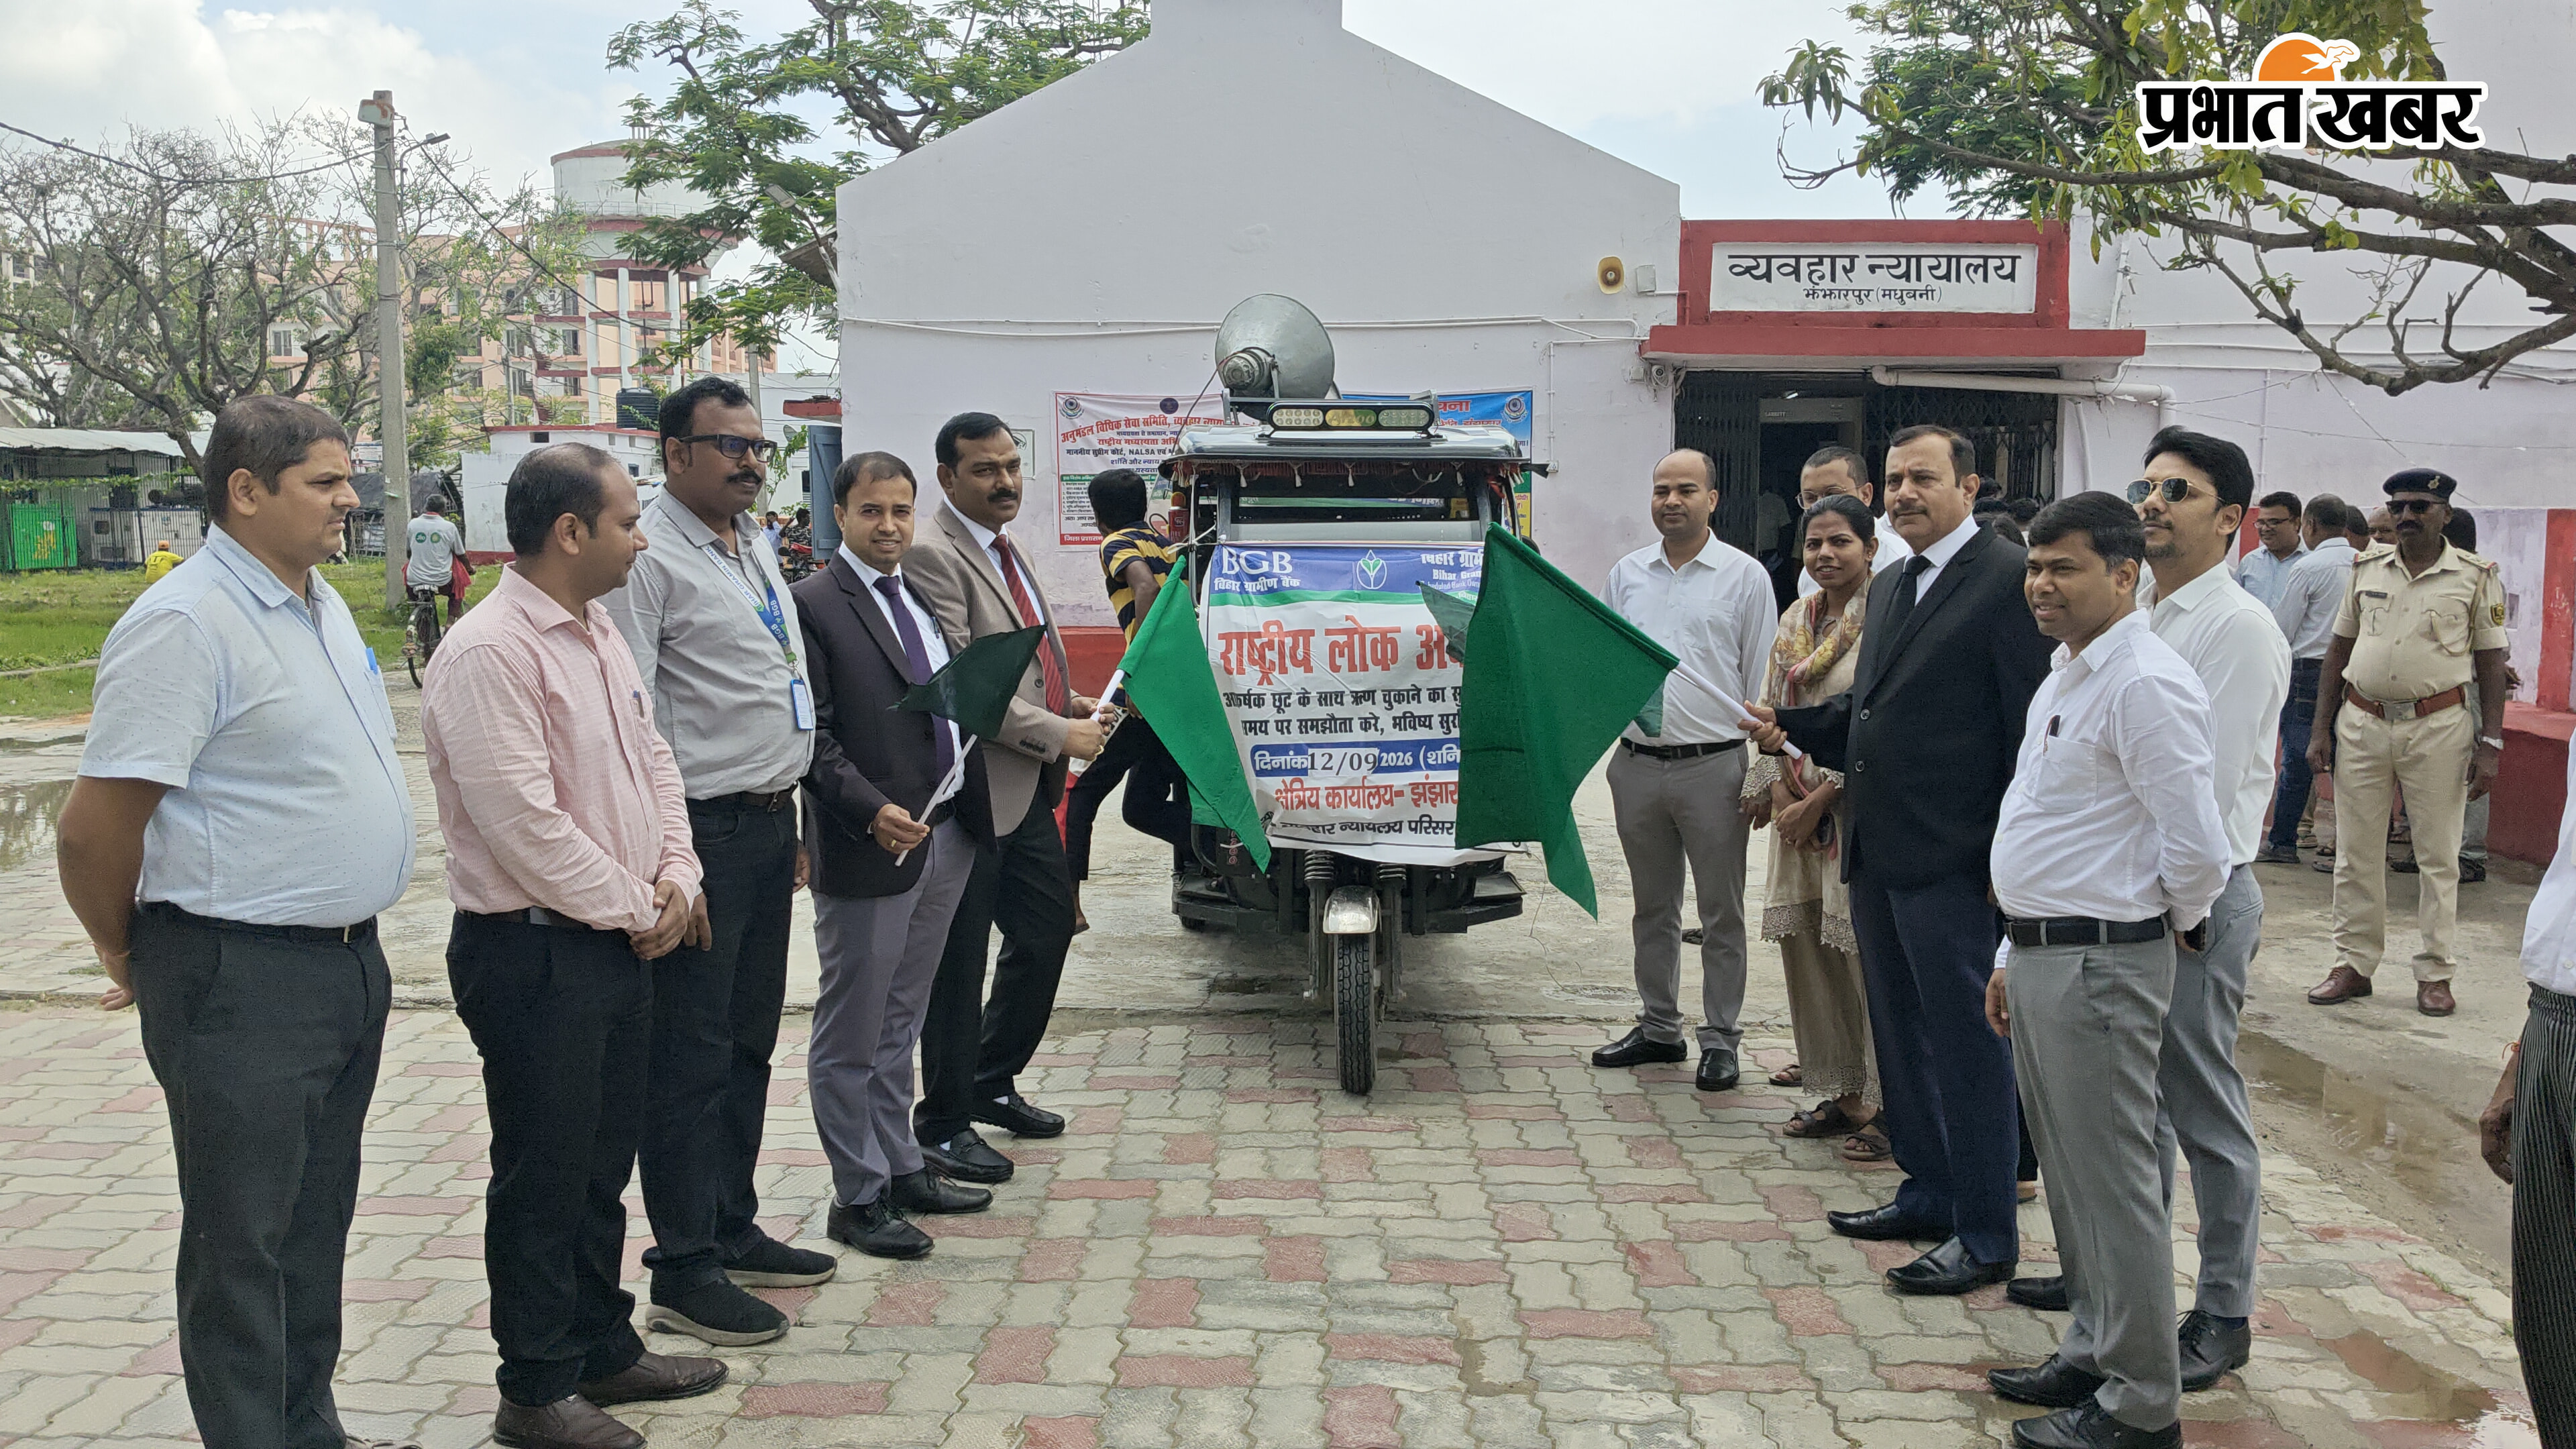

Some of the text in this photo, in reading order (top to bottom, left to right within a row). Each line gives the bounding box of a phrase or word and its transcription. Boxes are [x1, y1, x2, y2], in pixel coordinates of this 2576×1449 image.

[1728, 254, 2022, 286] व्यवहार न्यायालय
[1061, 425, 1094, 443] अनुमंडल
[1124, 417, 1140, 428] सेवा
[1097, 437, 1122, 447] राष्ट्रीय
[1066, 447, 1091, 455] माननीय
[1222, 546, 1293, 575] BGB
[704, 546, 763, 610] BIHAR GRAMIN BANK
[1214, 575, 1301, 592] बिहार ग्रामीण बैंक
[1432, 568, 1456, 580] Bihar
[770, 600, 780, 616] BGB
[771, 623, 785, 639] BGB
[1218, 619, 1316, 686] राष्ट्रीय
[1324, 614, 1401, 674] लोक
[1271, 691, 1292, 714] छूट
[1296, 687, 1311, 708] के
[1316, 690, 1345, 706] साथ
[1381, 684, 1422, 711] चुकाने
[1426, 686, 1447, 704] का
[1274, 717, 1292, 736] पर
[1295, 712, 1354, 735] समझौता
[1392, 710, 1434, 733] भविष्य
[1254, 749, 1308, 771] दिनांक
[1380, 751, 1414, 767] 2026
[1408, 773, 1458, 808] झंझार
[1407, 814, 1456, 836] परिसर
